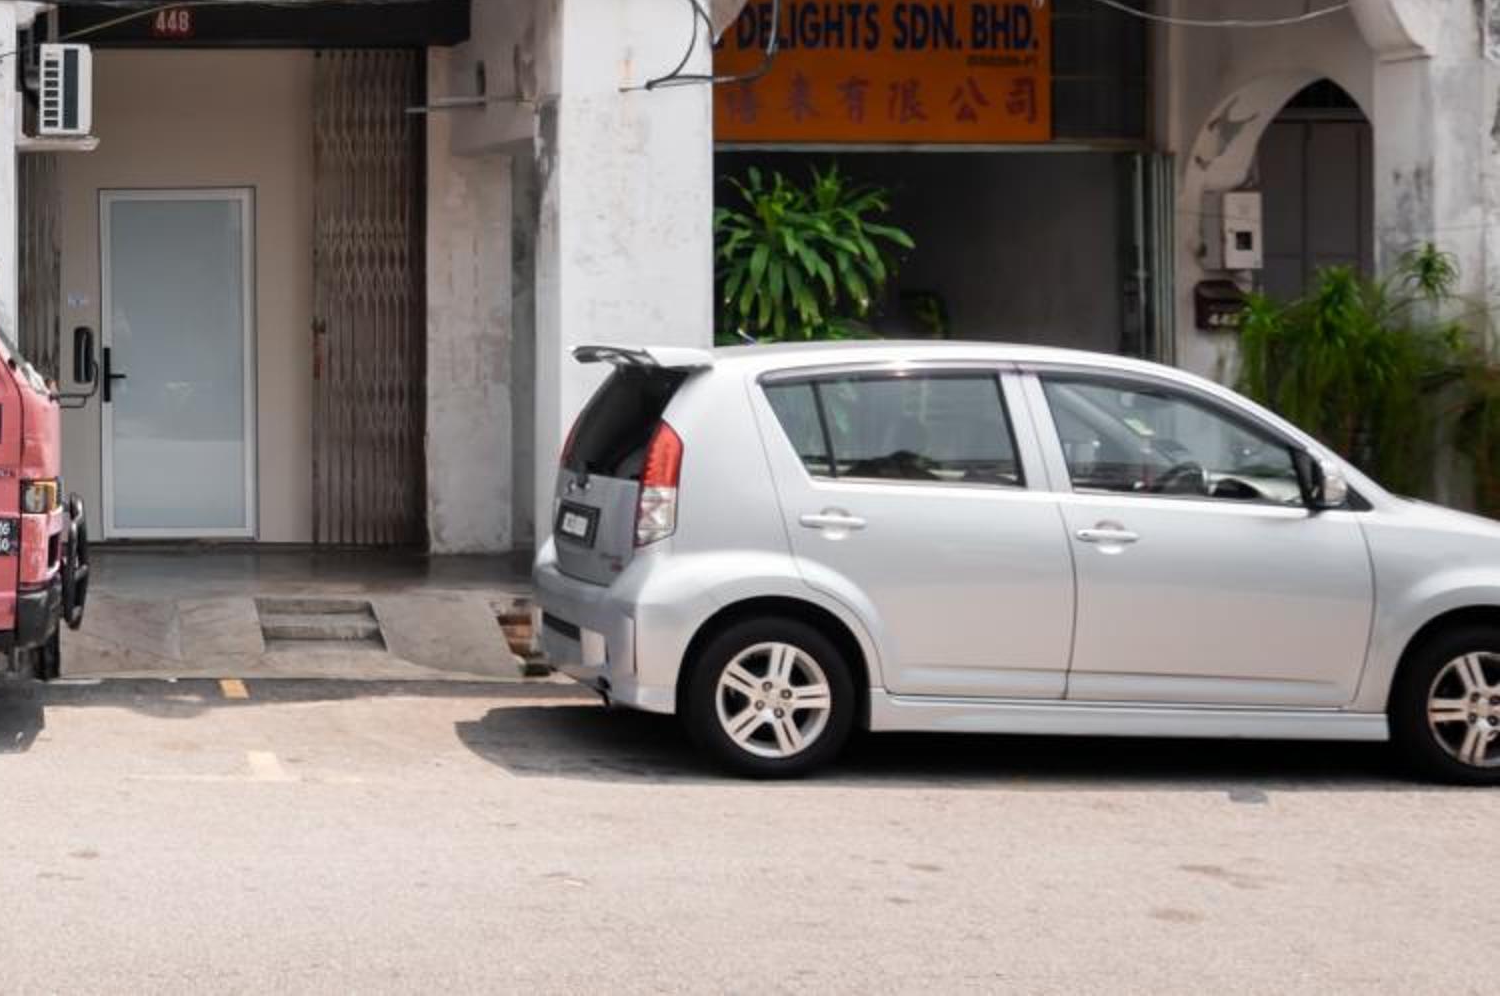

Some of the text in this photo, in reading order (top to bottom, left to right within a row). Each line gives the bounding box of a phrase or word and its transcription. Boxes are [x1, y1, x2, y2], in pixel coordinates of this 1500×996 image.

[156, 10, 189, 32] 448
[892, 2, 962, 51] SDN.
[970, 2, 1039, 50] BHD.
